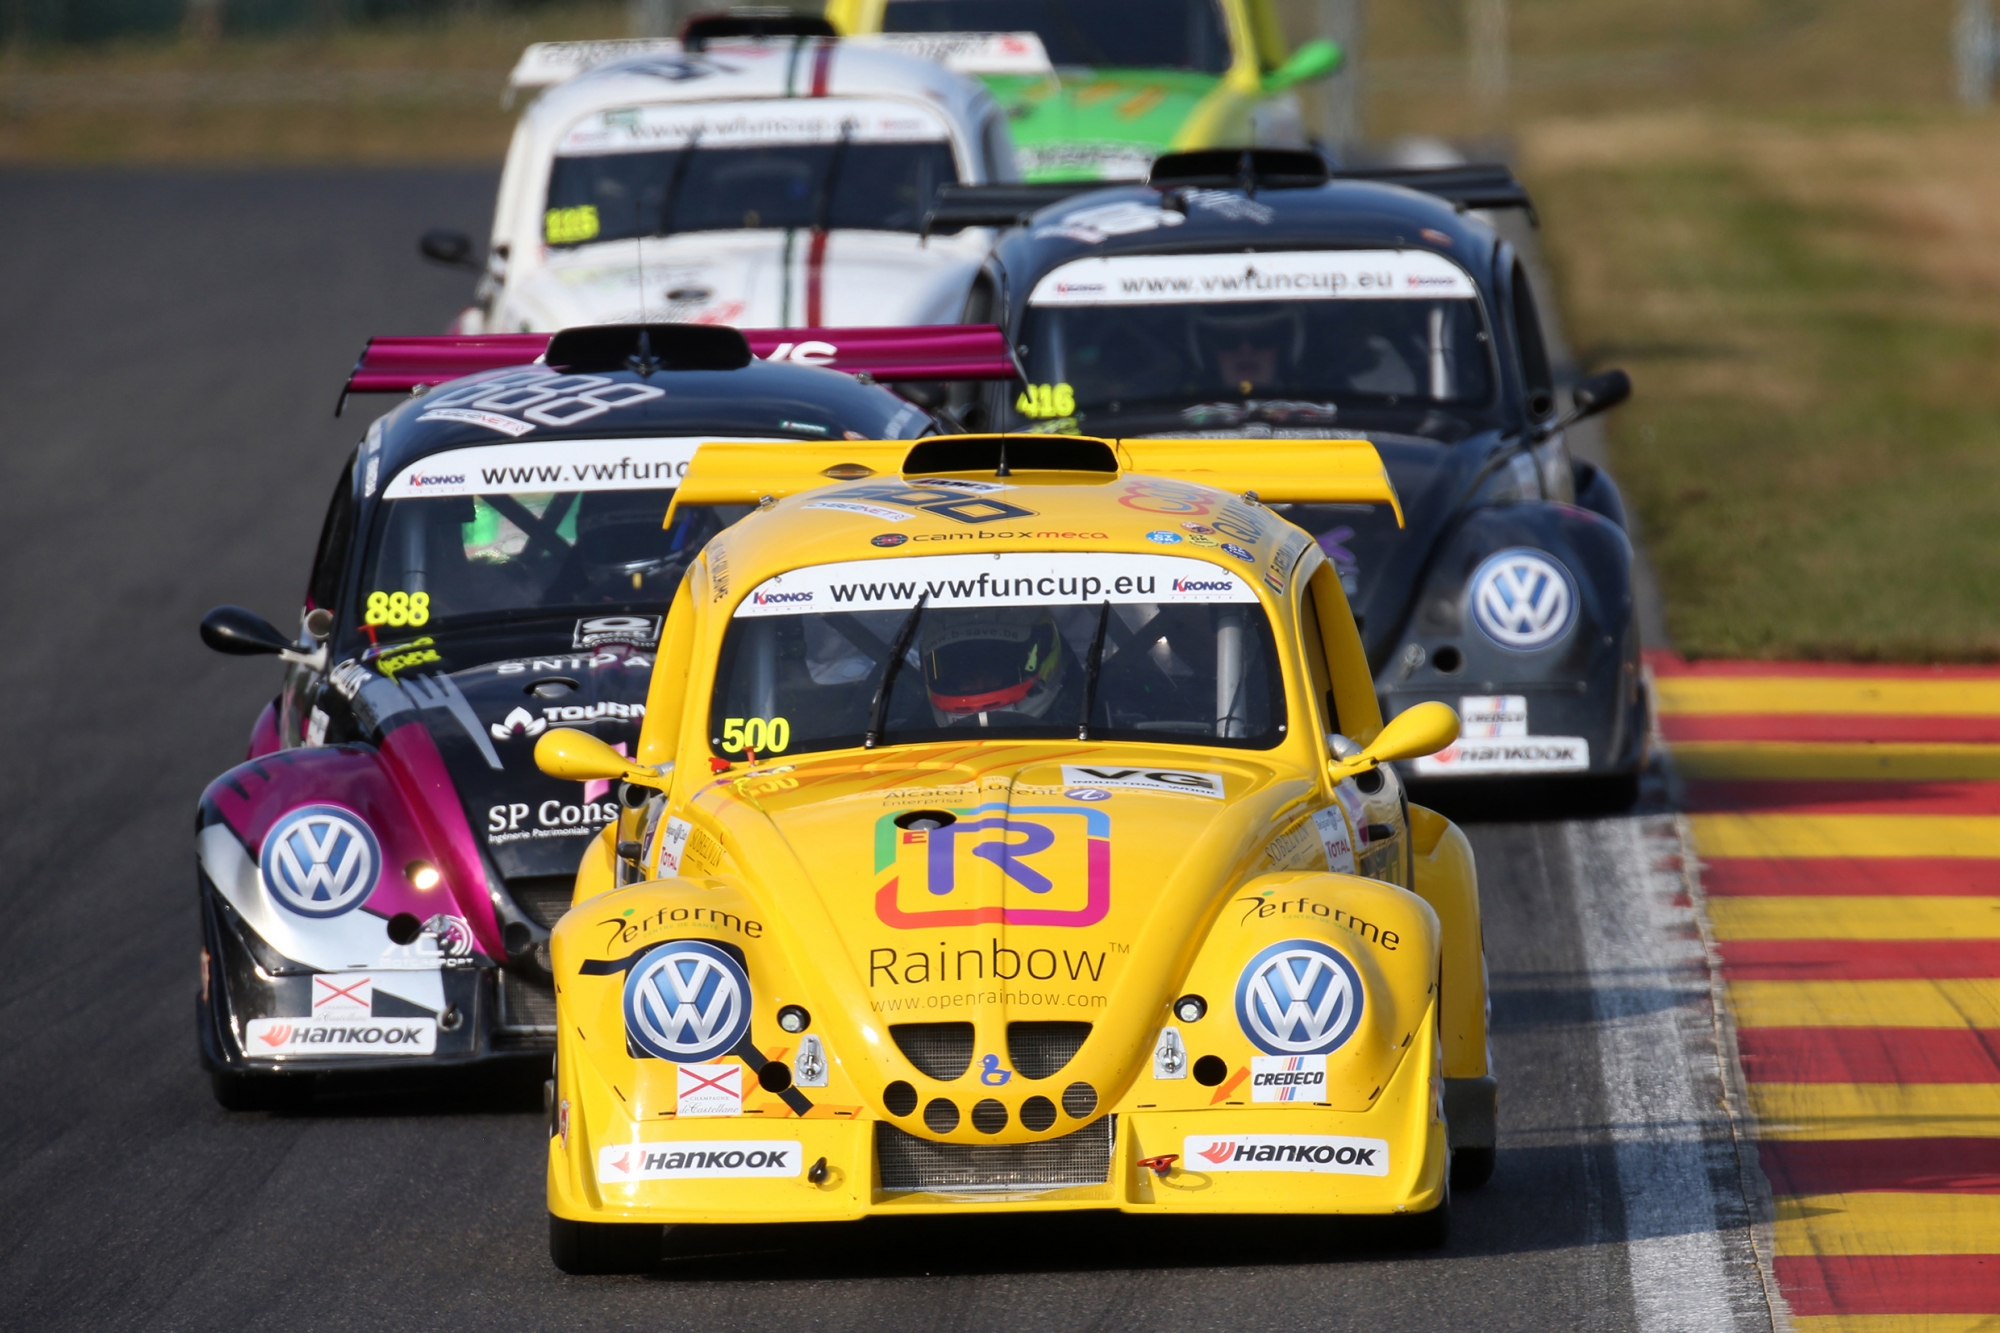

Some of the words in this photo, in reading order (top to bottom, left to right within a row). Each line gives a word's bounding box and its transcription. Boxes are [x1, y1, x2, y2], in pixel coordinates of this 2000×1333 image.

[1121, 266, 1392, 297] www.vwfuncup.eu
[1017, 383, 1076, 418] 416
[409, 470, 466, 487] KRONOS
[912, 530, 1109, 544] camboxmeca
[829, 572, 1156, 603] www.vwfuncup.eu
[1171, 576, 1233, 592] KRONOS
[752, 588, 814, 606] KRONOS
[365, 590, 430, 627] 888
[497, 653, 651, 674] SNIPA
[721, 716, 791, 754] 500
[1073, 767, 1215, 790] VG
[1073, 778, 1163, 791] INDUSTRIAL
[1166, 785, 1218, 796] WORK
[882, 797, 963, 808] Enterprise
[884, 783, 1056, 801] Alcatel-Lucent
[487, 802, 531, 833] SP
[537, 799, 621, 826] Cons
[531, 824, 590, 839] Patrimoniale
[660, 846, 678, 871] TOTAL
[1324, 838, 1351, 859] TOTAL
[869, 937, 1107, 988] Rainbow
[869, 990, 1108, 1015] www.openrainbow.com
[1253, 1070, 1326, 1088] CREDECO
